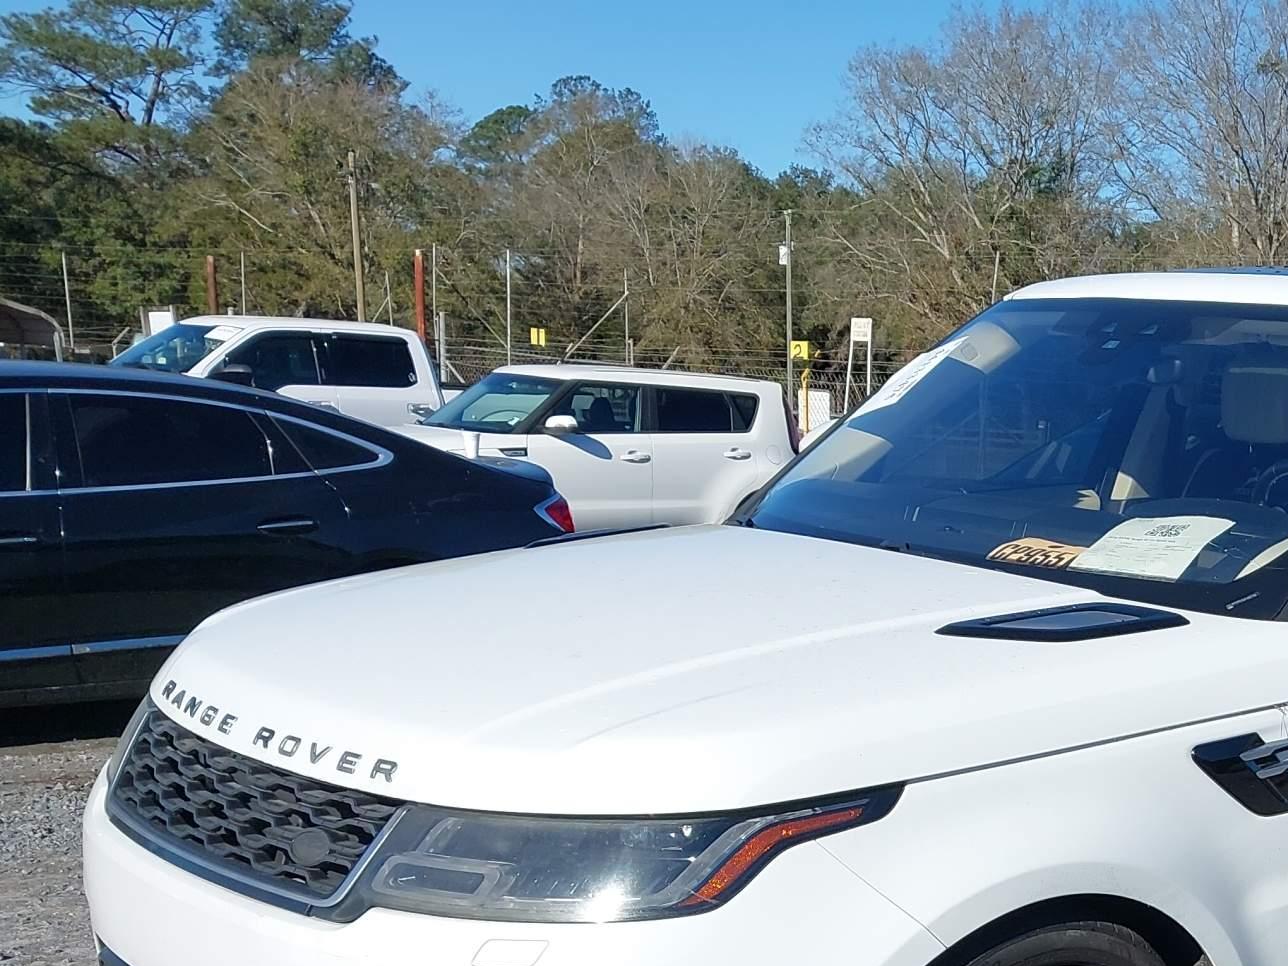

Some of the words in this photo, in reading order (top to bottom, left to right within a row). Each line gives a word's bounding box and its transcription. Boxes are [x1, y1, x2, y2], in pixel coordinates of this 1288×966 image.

[793, 343, 805, 360] 2
[162, 679, 239, 735] RANGE
[252, 726, 398, 783] ROVER
